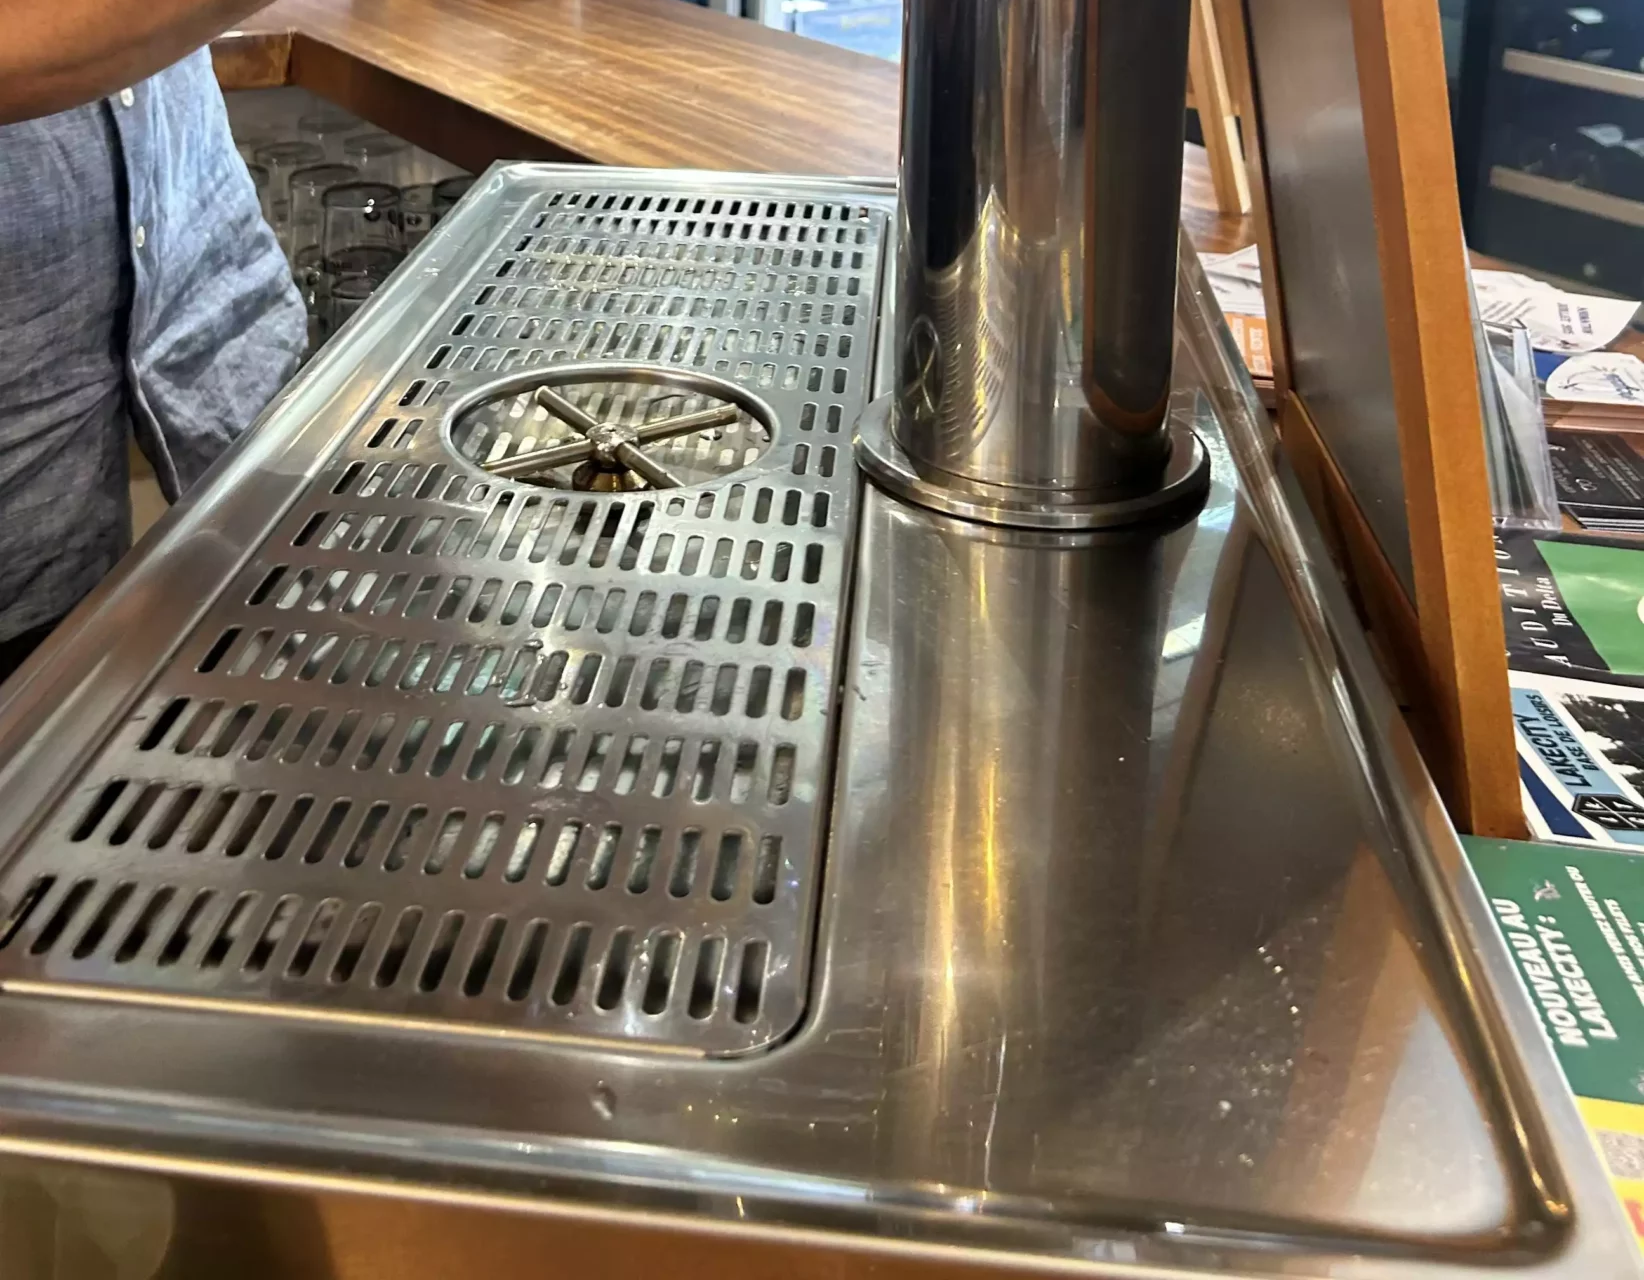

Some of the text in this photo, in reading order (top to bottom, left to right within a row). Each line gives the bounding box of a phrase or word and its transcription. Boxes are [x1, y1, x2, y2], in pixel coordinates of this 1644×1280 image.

[1535, 576, 1574, 627] Du Delta
[1511, 712, 1593, 788] LAKECITY
[1526, 694, 1601, 772] BASE DE LOISIRS
[1574, 881, 1608, 920] SAUTER
[1491, 898, 1590, 1048] NOUVEAU AU
[1535, 924, 1619, 1040] LAKECITY
